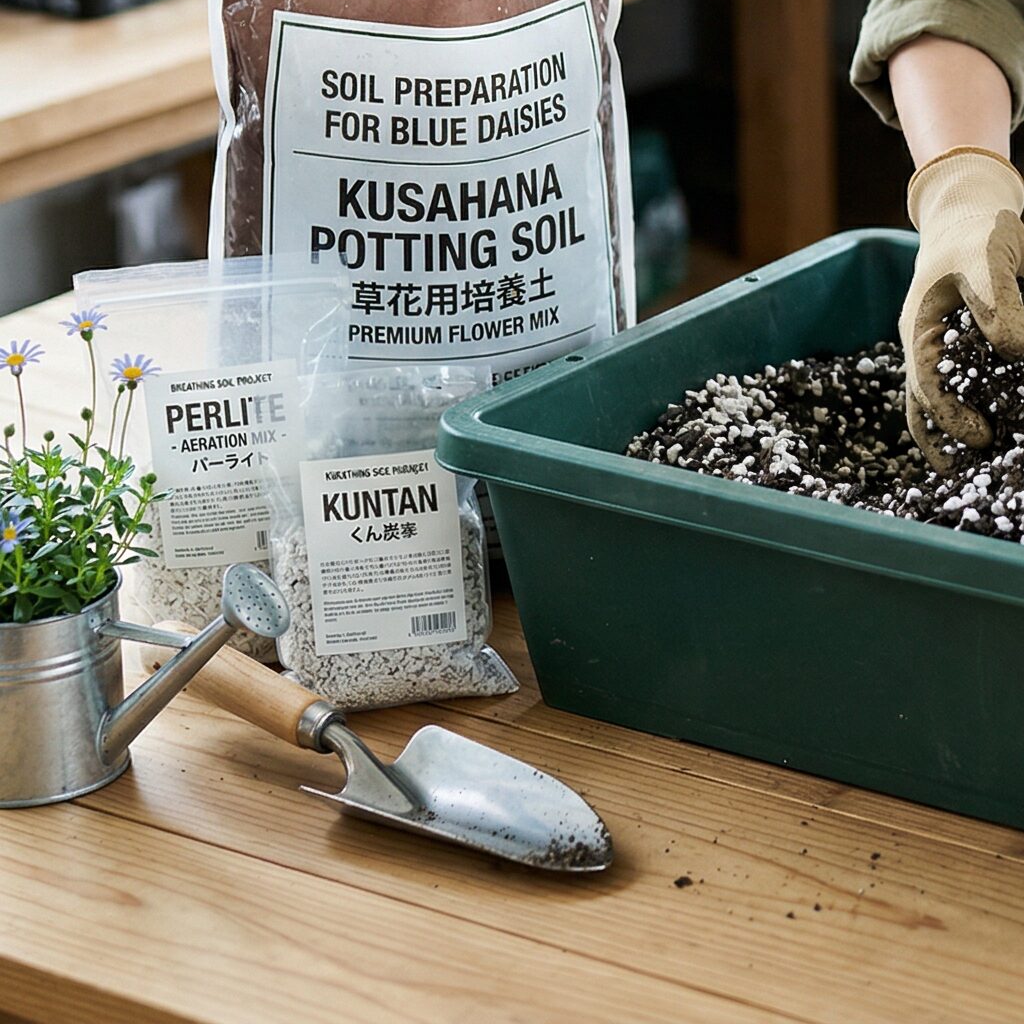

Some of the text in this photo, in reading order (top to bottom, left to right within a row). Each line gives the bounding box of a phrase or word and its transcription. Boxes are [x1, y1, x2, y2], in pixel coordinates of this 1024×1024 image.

[321, 52, 567, 107] SOIL PREPARATION
[325, 93, 567, 146] FOR BLUE DAISIES
[339, 163, 562, 222] KUSAHANA
[311, 206, 585, 272] POTTING SOIL
[351, 267, 556, 316] 草花用培養土
[349, 305, 559, 344] PREMIUM FLOWER MIX
[165, 393, 286, 434] PERLITE
[181, 432, 248, 453] AERATION
[250, 430, 277, 445] MIX
[322, 483, 439, 523] KUNTAN
